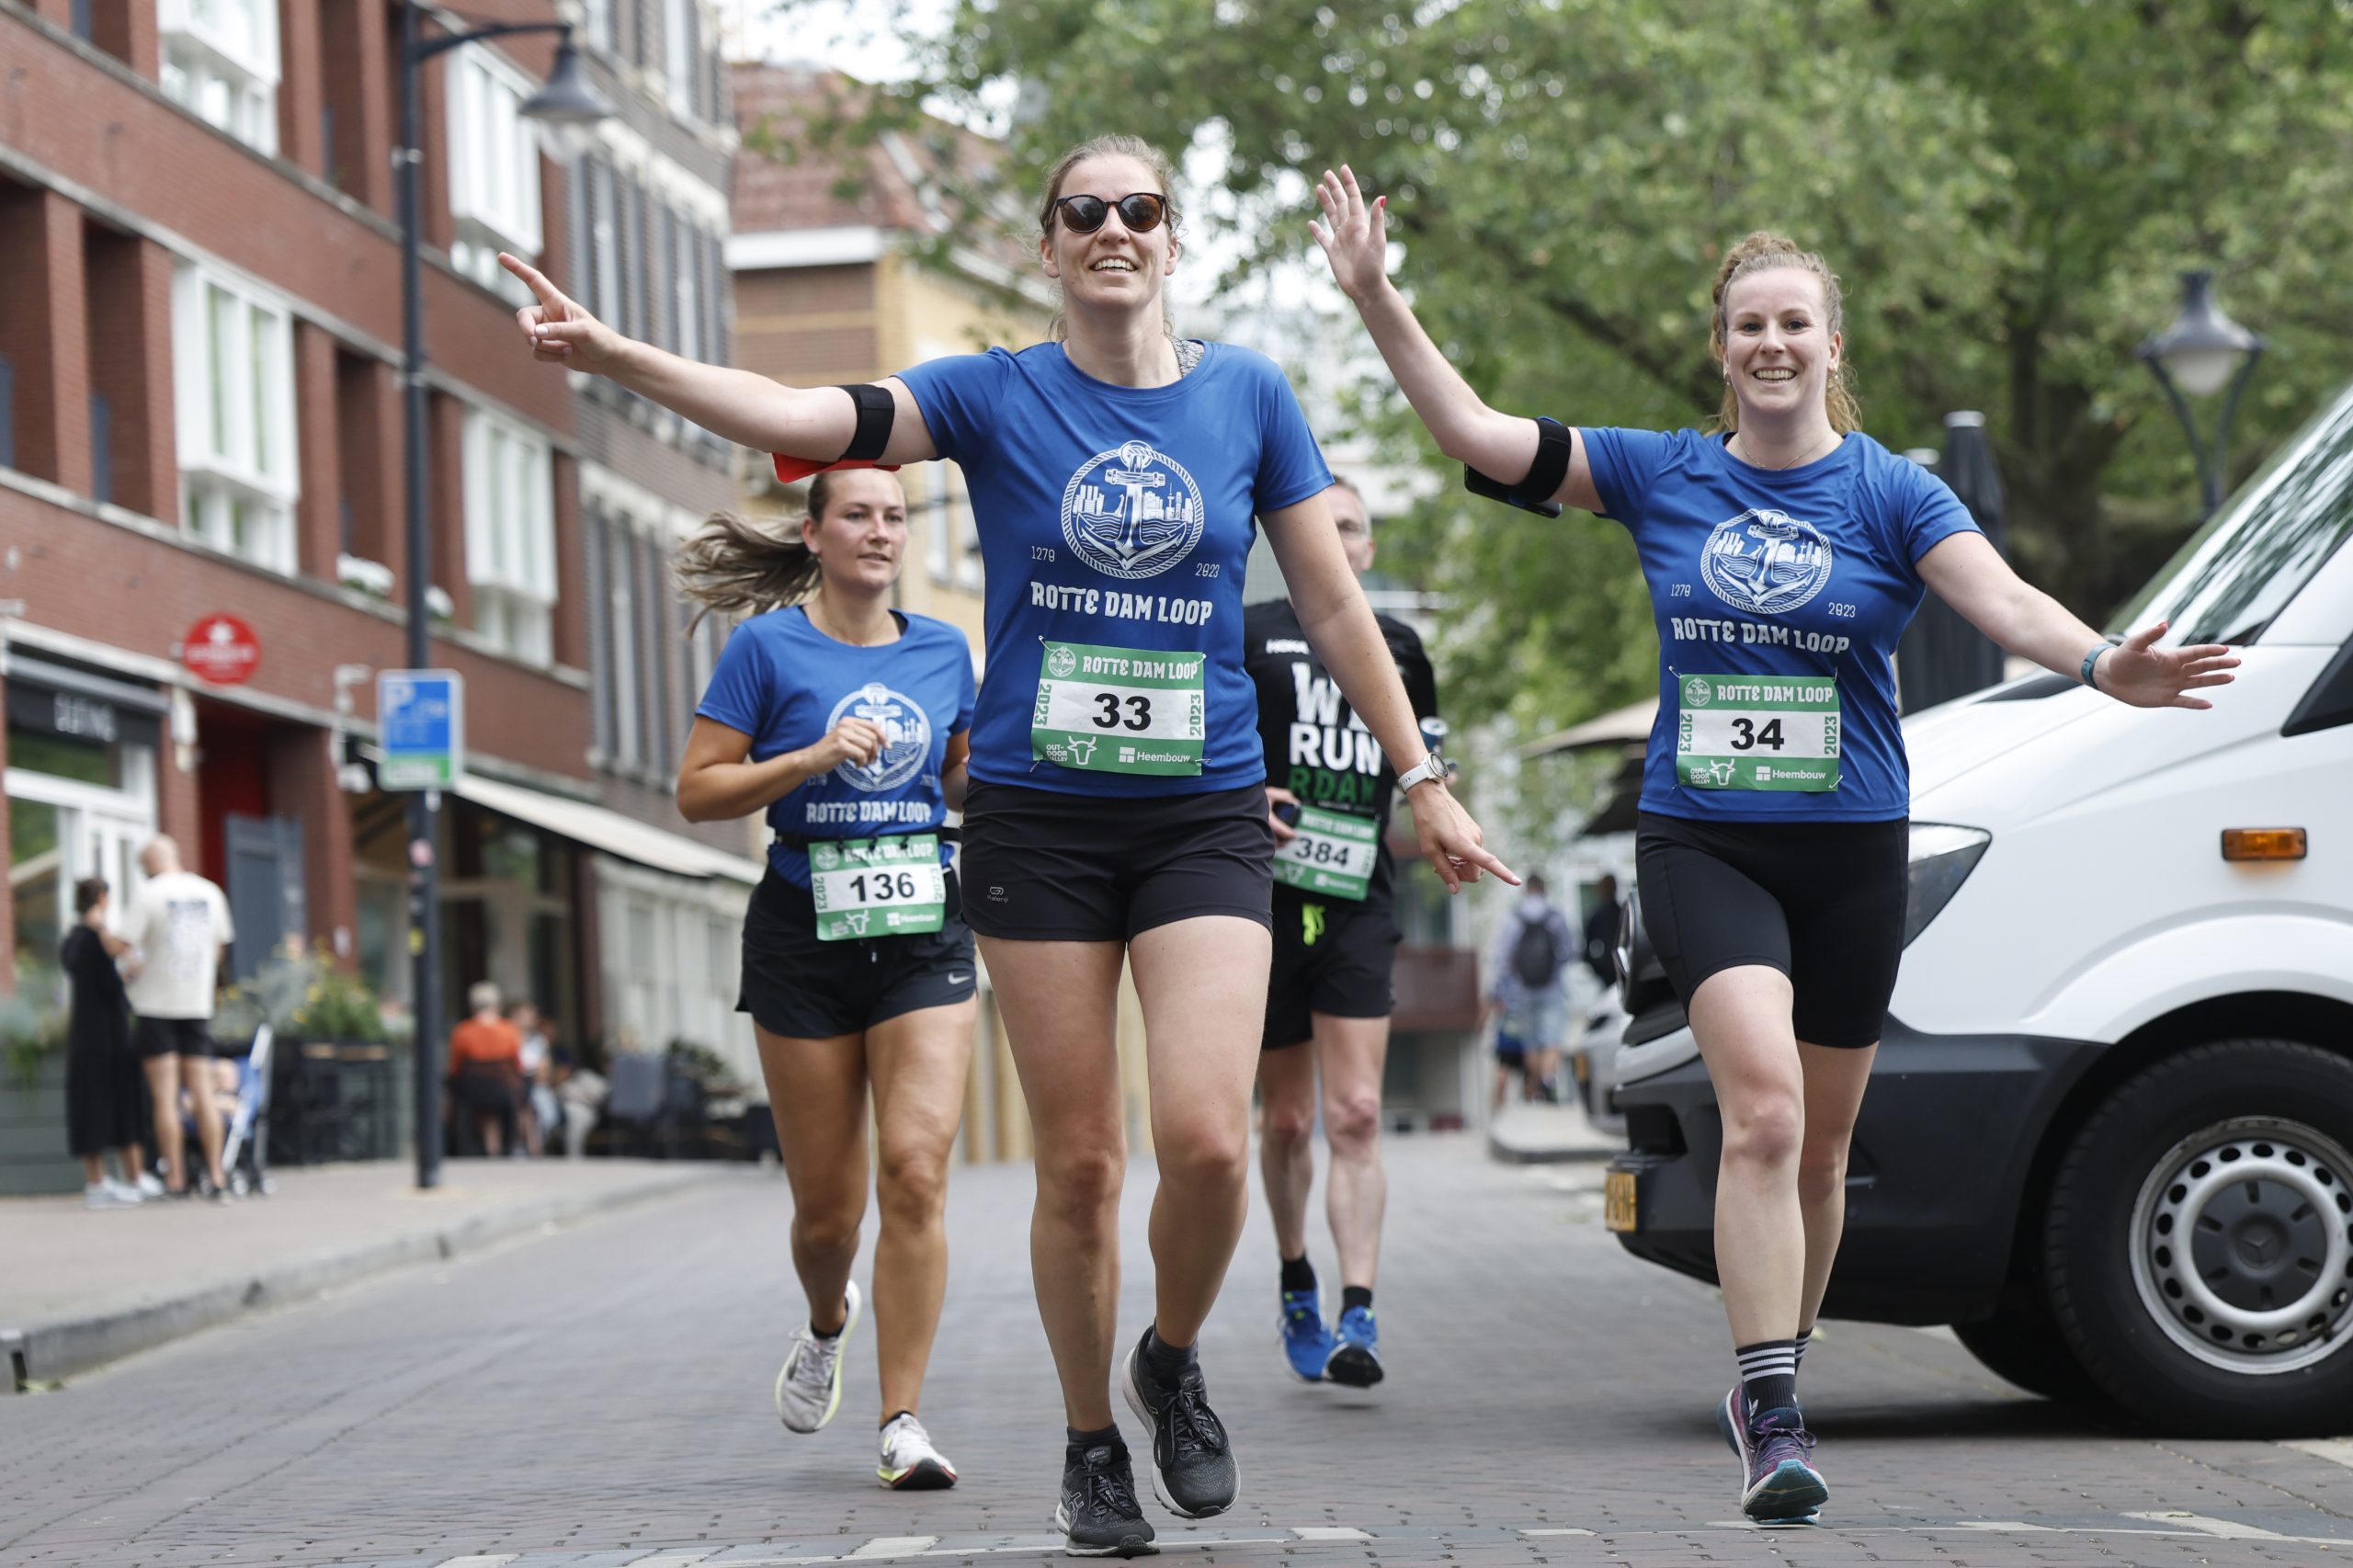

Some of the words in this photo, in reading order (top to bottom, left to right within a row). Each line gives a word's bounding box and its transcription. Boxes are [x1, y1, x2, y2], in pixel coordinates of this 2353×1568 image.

[1195, 562, 1221, 579] 2023
[1030, 581, 1100, 615] ROTTE
[1104, 591, 1154, 621] DAM
[1157, 597, 1213, 627] LOOP
[1827, 602, 1857, 619] 2023
[1670, 617, 1736, 644] ROTTE
[1740, 622, 1790, 646] DAM
[1792, 630, 1851, 654] LOOP
[1082, 655, 1130, 676] ROTTE
[1132, 659, 1165, 680] DAM
[1168, 662, 1199, 680] LOOP
[1033, 683, 1052, 727] 2023
[1716, 685, 1760, 702] ROTTE
[1763, 686, 1794, 703] DAM
[1796, 687, 1834, 704] LOOP
[1092, 692, 1152, 732] 33
[1188, 693, 1202, 737] 2023
[1289, 721, 1382, 778] RUN
[1678, 713, 1693, 754] 2023
[1730, 717, 1785, 751] 34
[1824, 715, 1837, 756] 2023
[1136, 750, 1191, 764] Heembouw
[1772, 768, 1826, 780] Heembouw
[805, 801, 858, 824] ROTTE
[858, 800, 898, 823] DAM
[898, 801, 932, 824] LOOP
[1294, 837, 1349, 868] 384
[813, 876, 828, 910] 2023
[848, 872, 915, 903] 136
